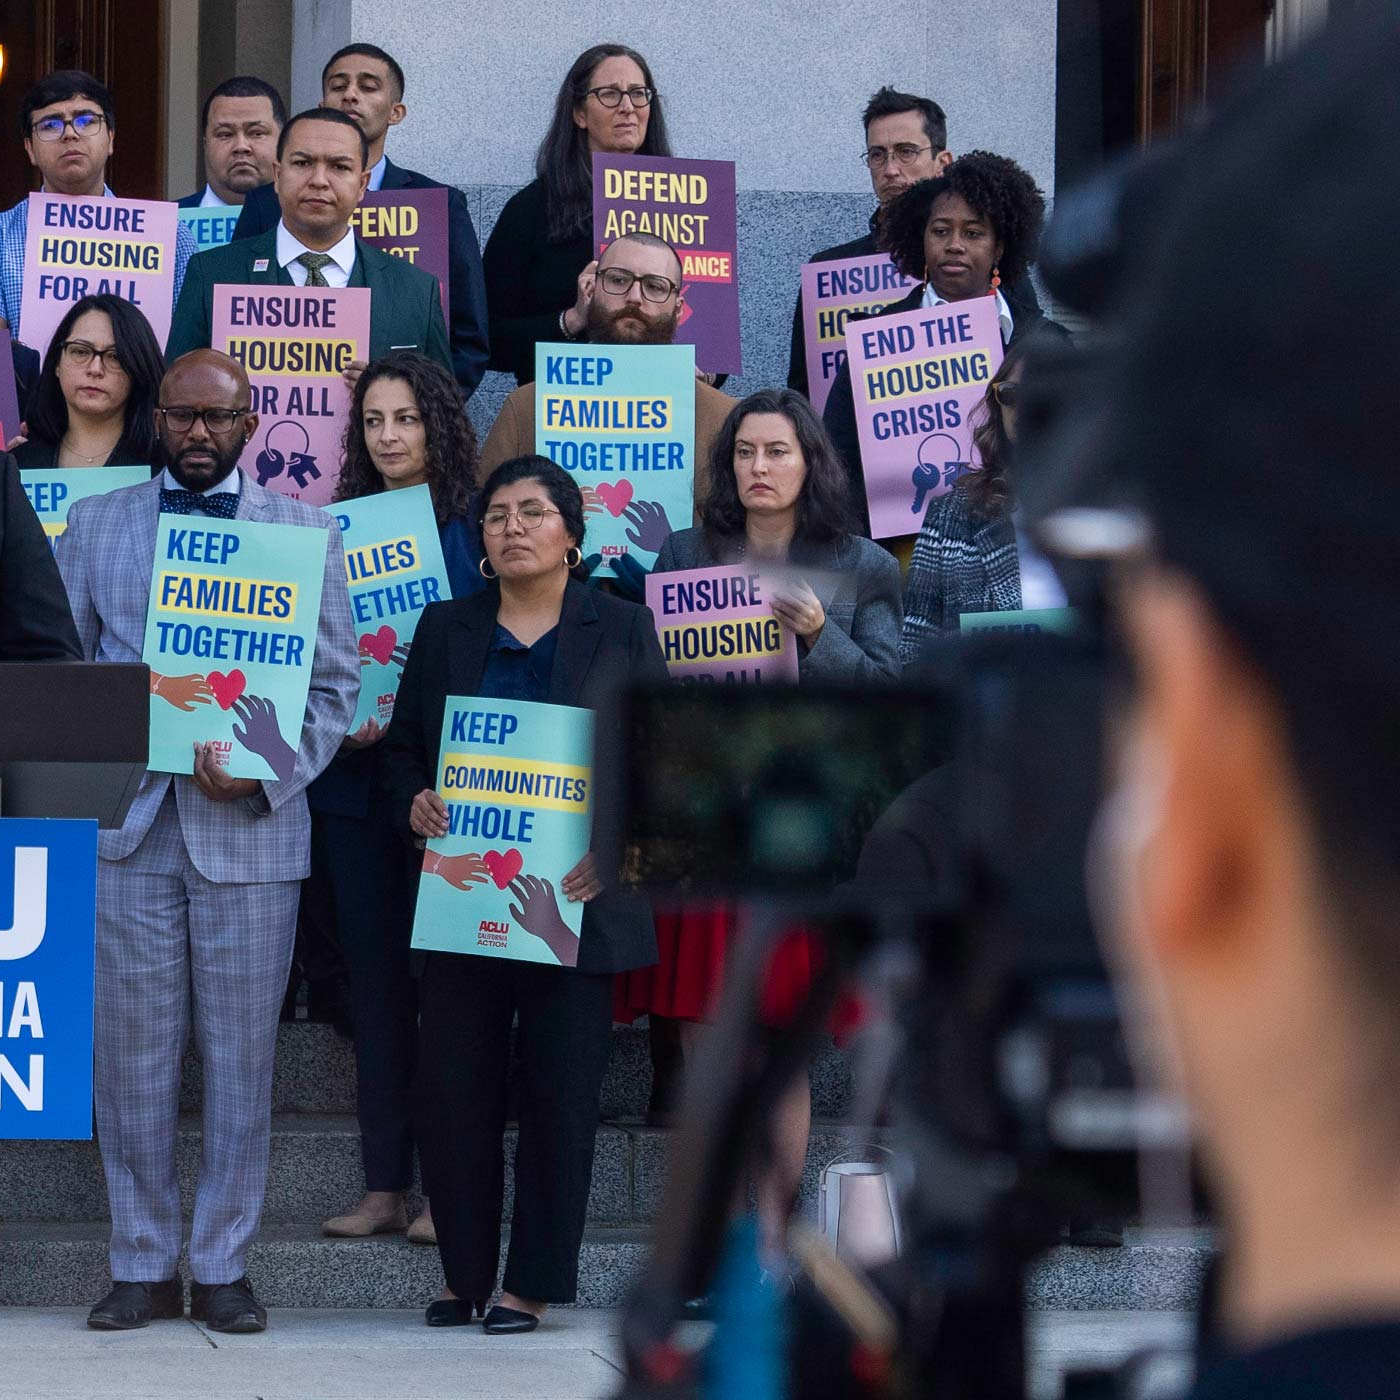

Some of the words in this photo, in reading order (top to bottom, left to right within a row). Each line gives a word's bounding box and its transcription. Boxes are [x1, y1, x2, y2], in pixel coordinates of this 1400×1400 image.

[604, 169, 708, 205] DEFEND
[44, 202, 145, 233] ENSURE
[348, 206, 419, 237] FEND
[604, 209, 709, 245] AGAINST
[42, 239, 160, 270] HOUSING
[39, 275, 88, 301] FOR
[230, 296, 336, 328] ENSURE
[862, 325, 915, 360] END
[919, 313, 973, 347] THE
[229, 340, 352, 374] HOUSING
[546, 356, 613, 386] KEEP
[867, 353, 989, 400] HOUSING
[249, 385, 279, 416] OR
[286, 387, 334, 417] ALL
[546, 398, 667, 428] FAMILIES
[872, 400, 961, 441] CRISIS
[545, 440, 684, 471] TOGETHER
[167, 528, 240, 565] KEEP
[347, 540, 415, 582] ILIES
[600, 545, 628, 556] ACLU
[161, 575, 292, 618] FAMILIES
[352, 576, 441, 625] ETHER
[662, 574, 762, 615] ENSURE
[157, 621, 304, 667] TOGETHER
[663, 619, 780, 661] HOUSING
[450, 710, 518, 745] KEEP
[444, 765, 587, 802] COMMUNITIES
[447, 804, 535, 843] WHOLE
[477, 940, 508, 948] ACTION
[479, 920, 509, 934] ACLU
